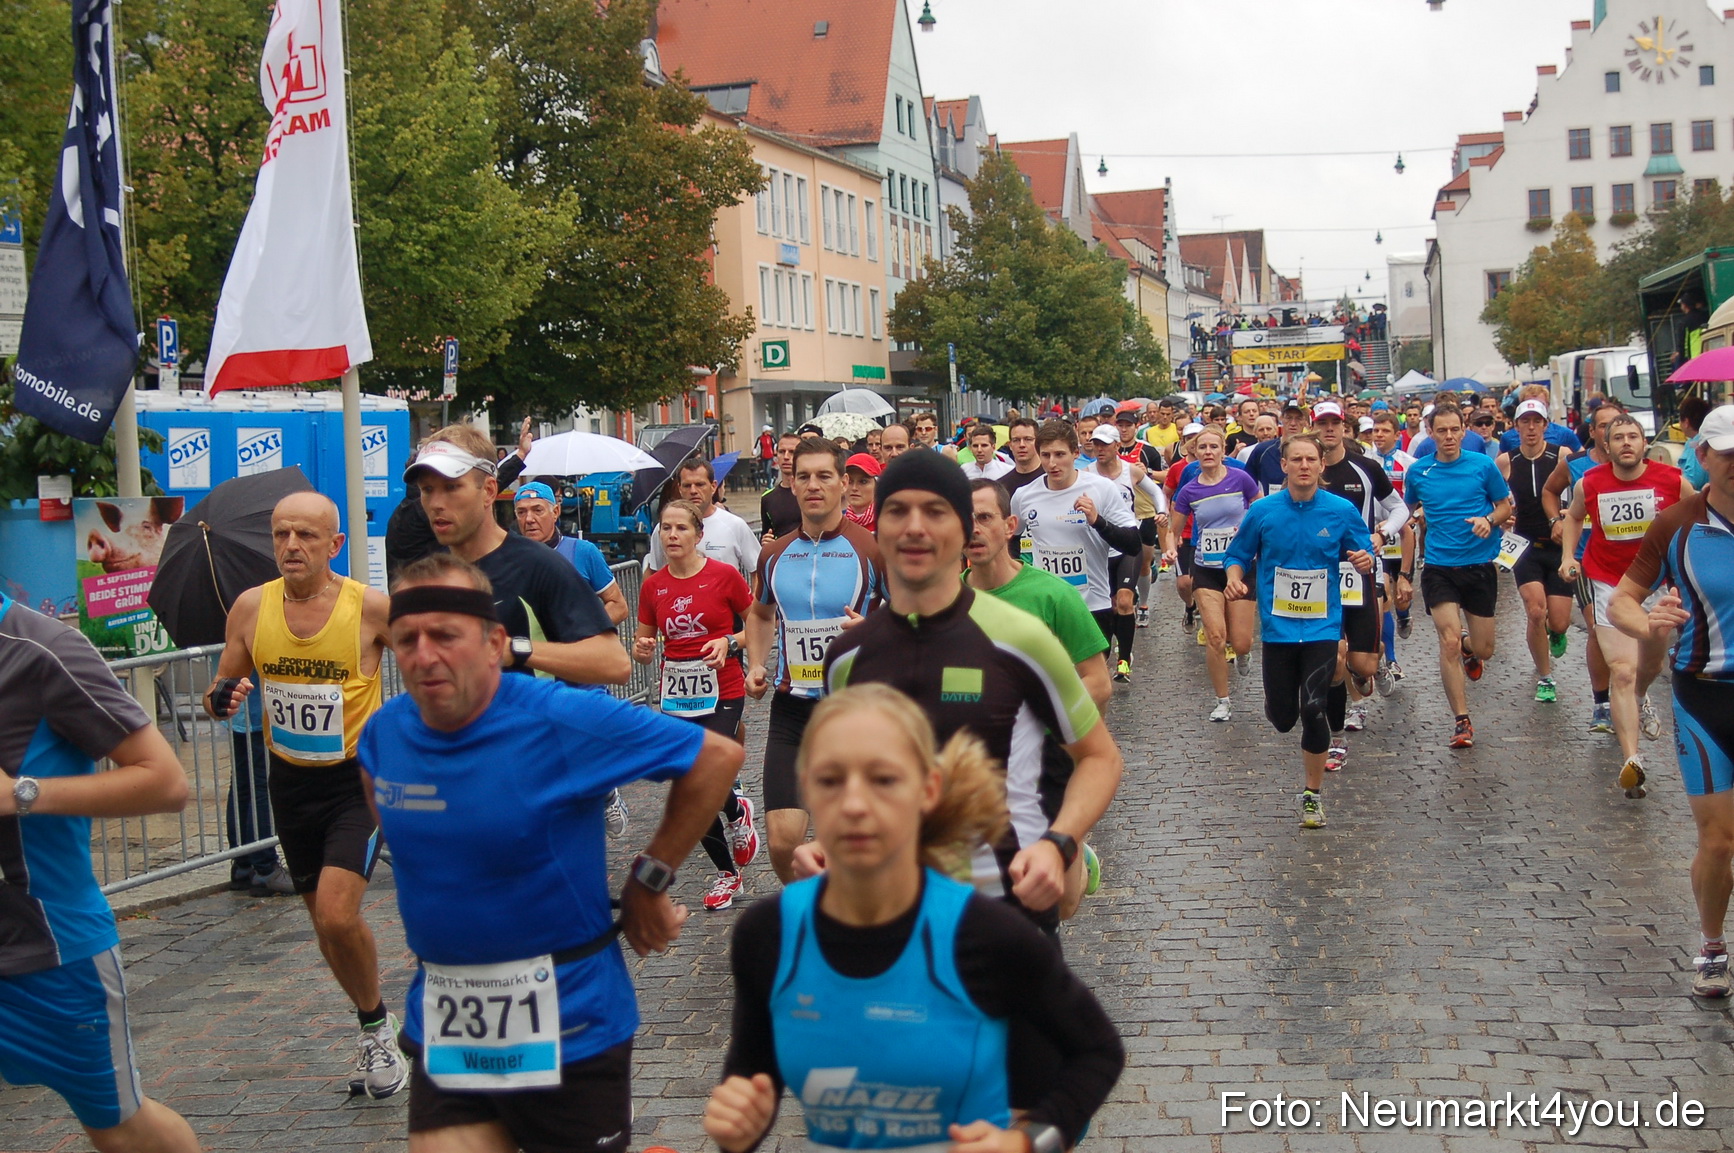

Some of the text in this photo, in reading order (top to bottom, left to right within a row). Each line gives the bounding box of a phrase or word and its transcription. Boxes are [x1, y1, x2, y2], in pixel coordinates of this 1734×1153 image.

[162, 325, 174, 359] P
[447, 344, 456, 370] P
[766, 345, 786, 364] D
[1268, 350, 1306, 360] START
[1610, 502, 1644, 522] 236
[1616, 526, 1642, 534] Torsten
[1501, 540, 1518, 554] 29
[1042, 556, 1082, 574] 3160
[107, 570, 148, 584] SEPTEMBER
[89, 581, 153, 602] BEIDE STIMM
[1290, 582, 1312, 600] 87
[115, 594, 142, 608] GRÜN
[1288, 603, 1312, 612] Steven
[134, 620, 157, 634] UND
[666, 612, 708, 637] ASK
[804, 624, 839, 634] Neumarkt
[278, 656, 335, 668] SPORTHAUS
[802, 668, 824, 678] Andr
[668, 674, 713, 696] 2475
[266, 686, 327, 700] PARTL Neumarkt
[941, 692, 981, 702] DATEV
[676, 700, 705, 710] Irmgard
[272, 698, 335, 732] 3167
[427, 974, 529, 989] PARTL Neumarkt
[436, 990, 541, 1040] 2371
[463, 1051, 524, 1070] Werner
